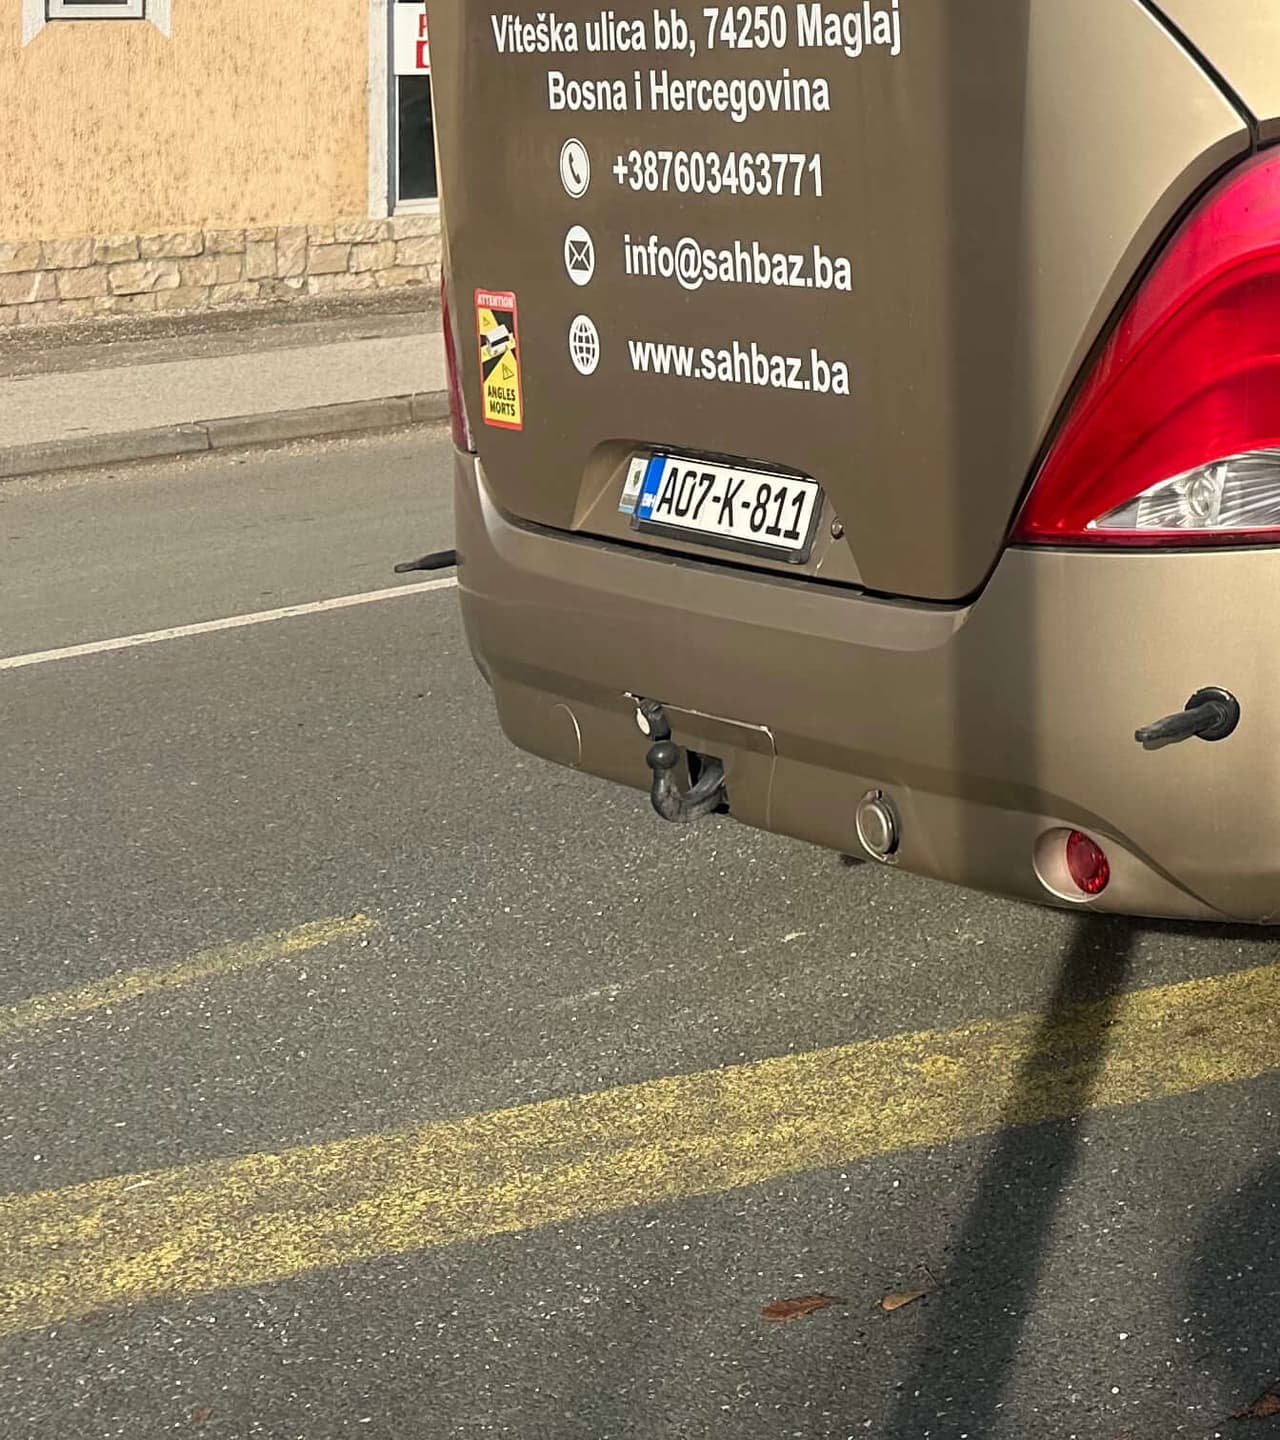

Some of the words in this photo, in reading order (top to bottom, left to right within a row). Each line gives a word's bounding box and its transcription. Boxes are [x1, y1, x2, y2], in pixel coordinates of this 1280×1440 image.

[491, 12, 579, 54] Viteška
[586, 11, 647, 52] ulica
[653, 9, 696, 58] bb,
[703, 5, 787, 50] 74250
[548, 71, 628, 112] Bosna
[634, 70, 643, 111] i
[650, 69, 831, 123] Hercegovina
[613, 151, 823, 197] +387603463771
[624, 234, 853, 291] info@sahbaz.ba
[487, 385, 516, 402] ANGLES
[628, 340, 850, 396] www.sahbaz.ba
[489, 400, 516, 417] MORTS
[656, 465, 807, 541] A07-K-811
